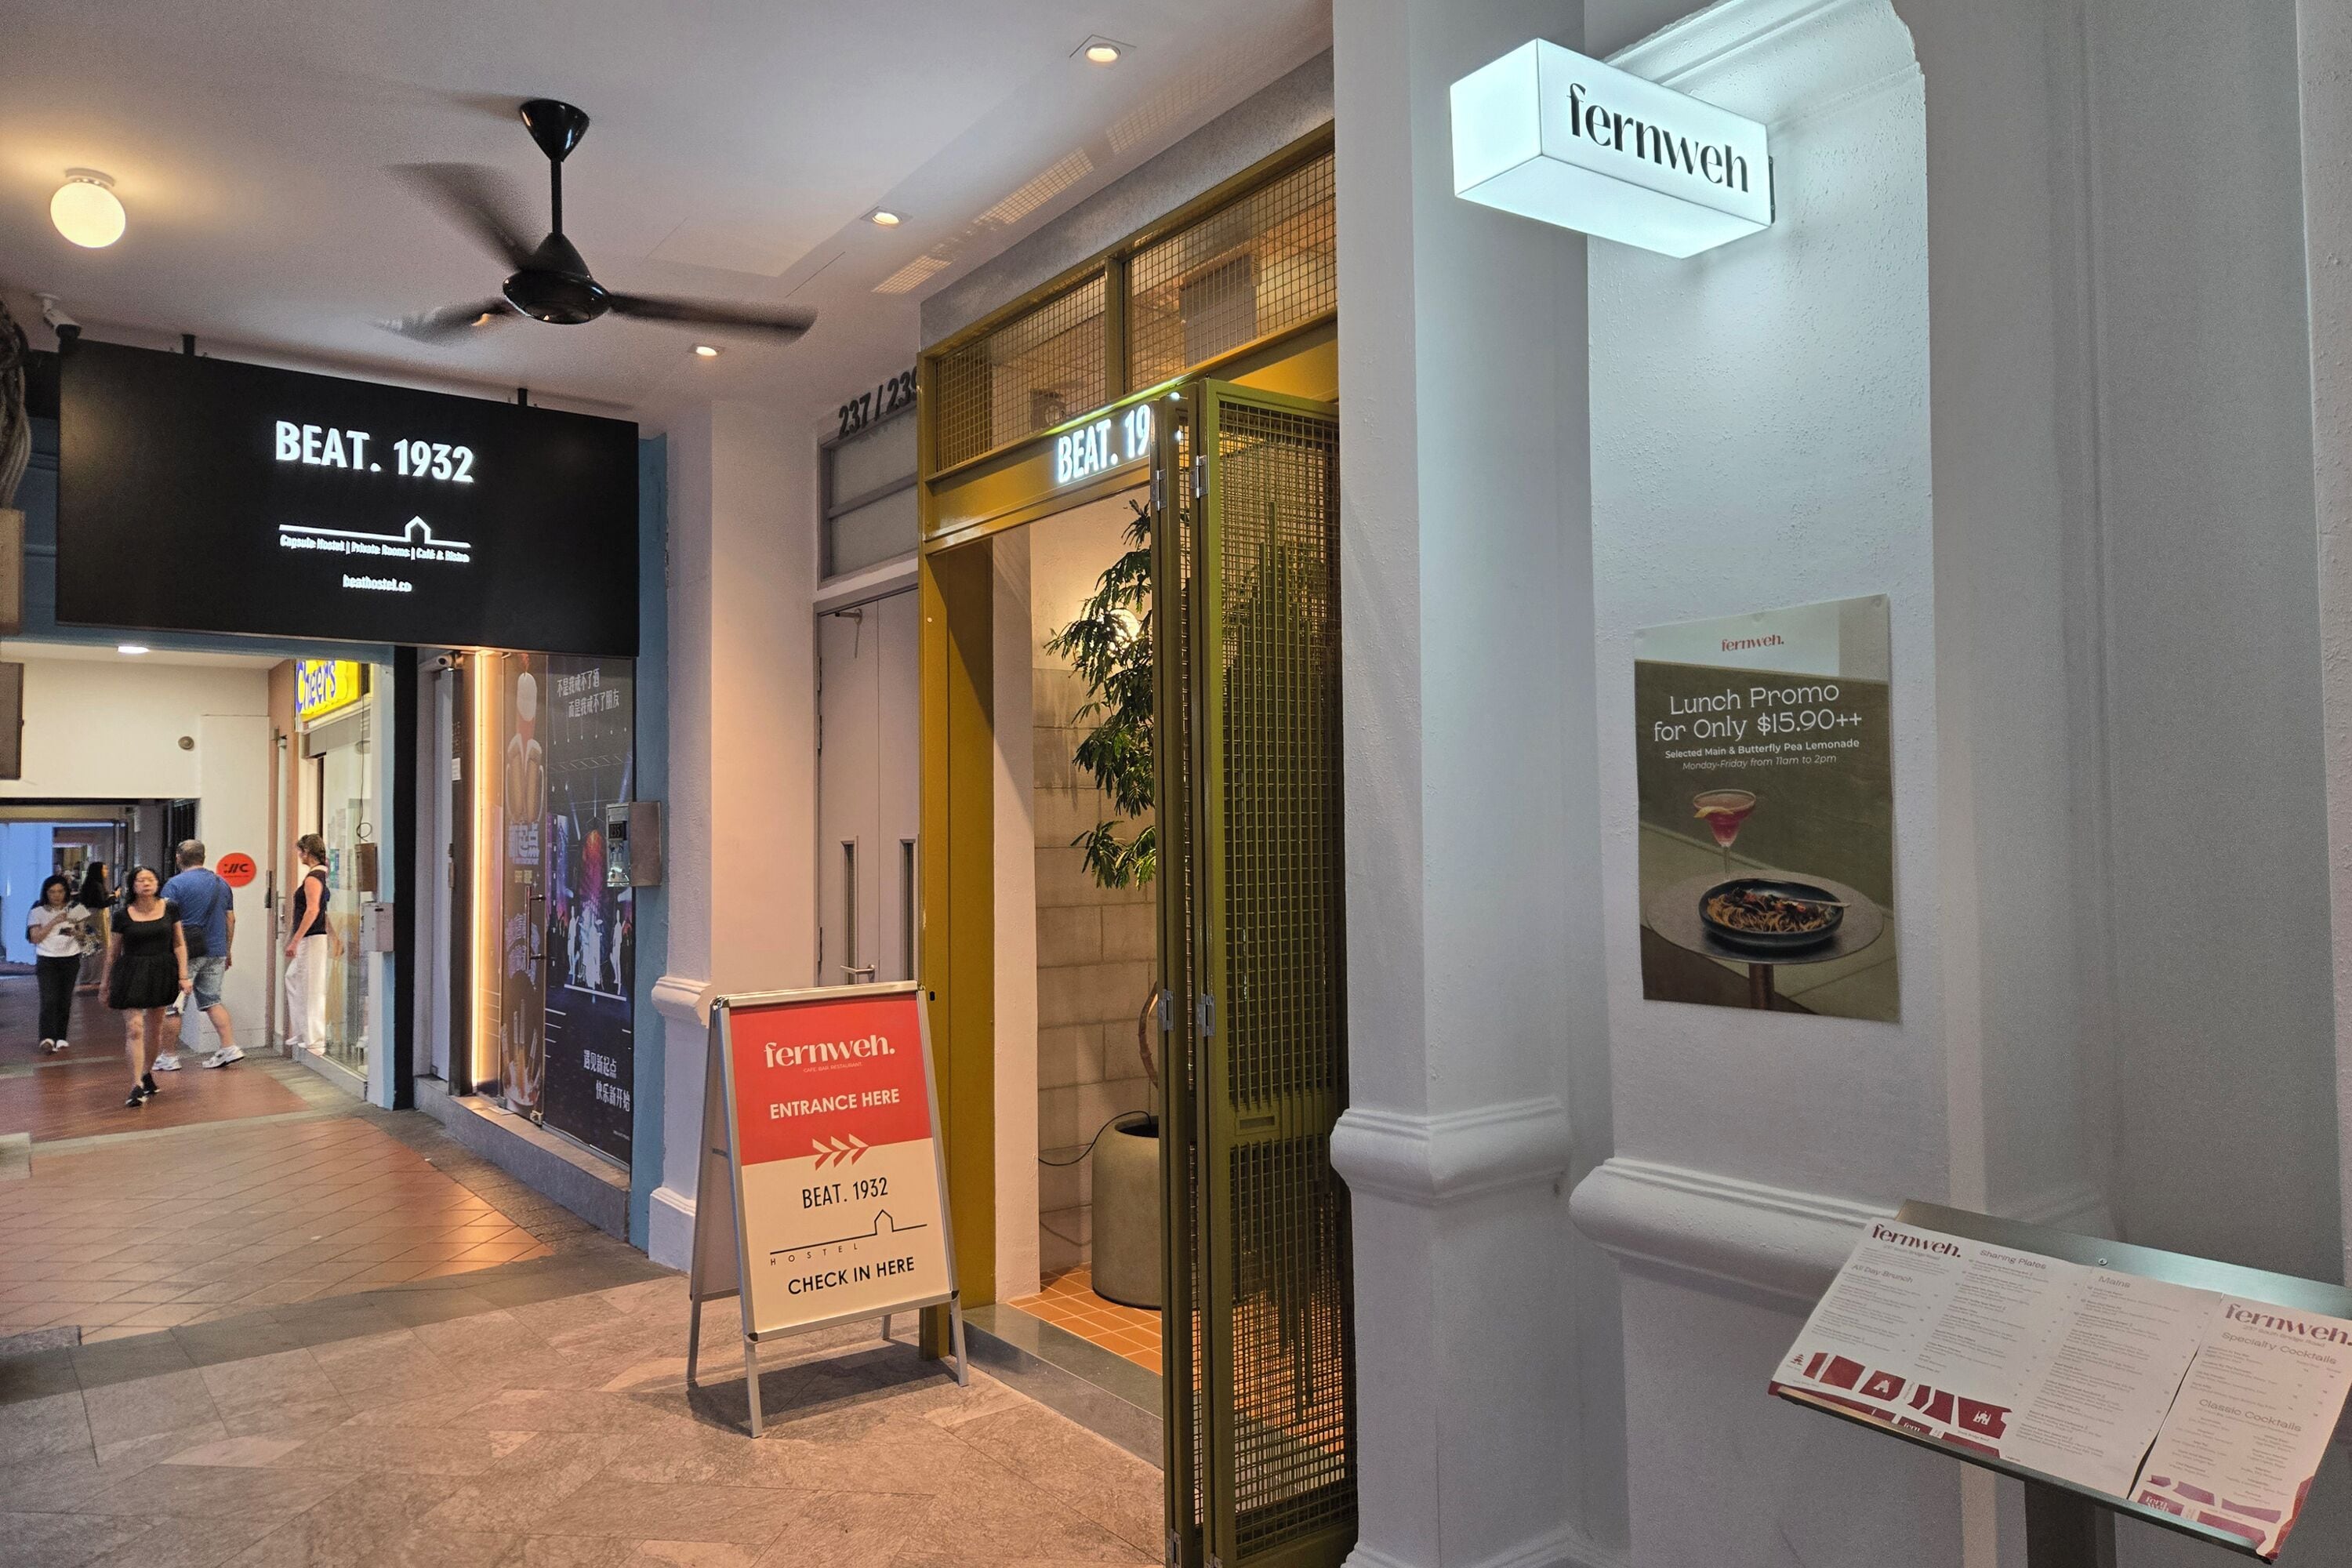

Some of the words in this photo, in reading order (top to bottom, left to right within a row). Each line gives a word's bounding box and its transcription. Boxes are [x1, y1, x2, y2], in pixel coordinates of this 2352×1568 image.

[1566, 83, 1749, 193] fernweh
[838, 392, 871, 439] 237
[276, 420, 381, 472] BEAT.
[394, 438, 474, 483] 1932
[1058, 418, 1119, 483] BEAT.
[280, 535, 316, 549] Capsule
[316, 538, 345, 552] Hostel
[351, 542, 380, 555] Private
[381, 544, 410, 557] Rooms
[343, 574, 412, 592] beathostel.co
[1721, 634, 1784, 652] fernweh.
[1670, 689, 1740, 715] Lunch
[1750, 684, 1839, 708] Promo
[1654, 721, 1686, 742] for
[1693, 716, 1748, 742] Only
[1757, 709, 1862, 735] $15.90++
[1665, 750, 1702, 759] Selected
[1705, 747, 1726, 757] Main
[1738, 743, 1781, 754] Butterfly
[1784, 742, 1802, 751] Pea
[1806, 739, 1860, 750] Lemonade
[1682, 759, 1748, 771] Monday-Friday
[1750, 757, 1773, 767] from
[1776, 756, 1799, 765] 11am
[1814, 754, 1837, 765] 2pm
[764, 1034, 895, 1068] fernweh.
[770, 1094, 857, 1120] ENTRANCE
[862, 1088, 900, 1108] HERE
[802, 1183, 848, 1209] BEAT.
[852, 1177, 888, 1200] 1932
[1872, 1223, 1961, 1258] fernweh.
[788, 1271, 848, 1294] CHECK
[854, 1265, 870, 1283] IN
[877, 1257, 915, 1277] HERE
[1980, 1249, 2016, 1265] Sharing
[2018, 1257, 2047, 1270] Plates
[2098, 1276, 2131, 1288] Mains
[2221, 1332, 2277, 1351] Specialty
[2280, 1345, 2337, 1365] Cocktails
[2199, 1399, 2241, 1416] Classic
[2245, 1411, 2303, 1432] Cocktails
